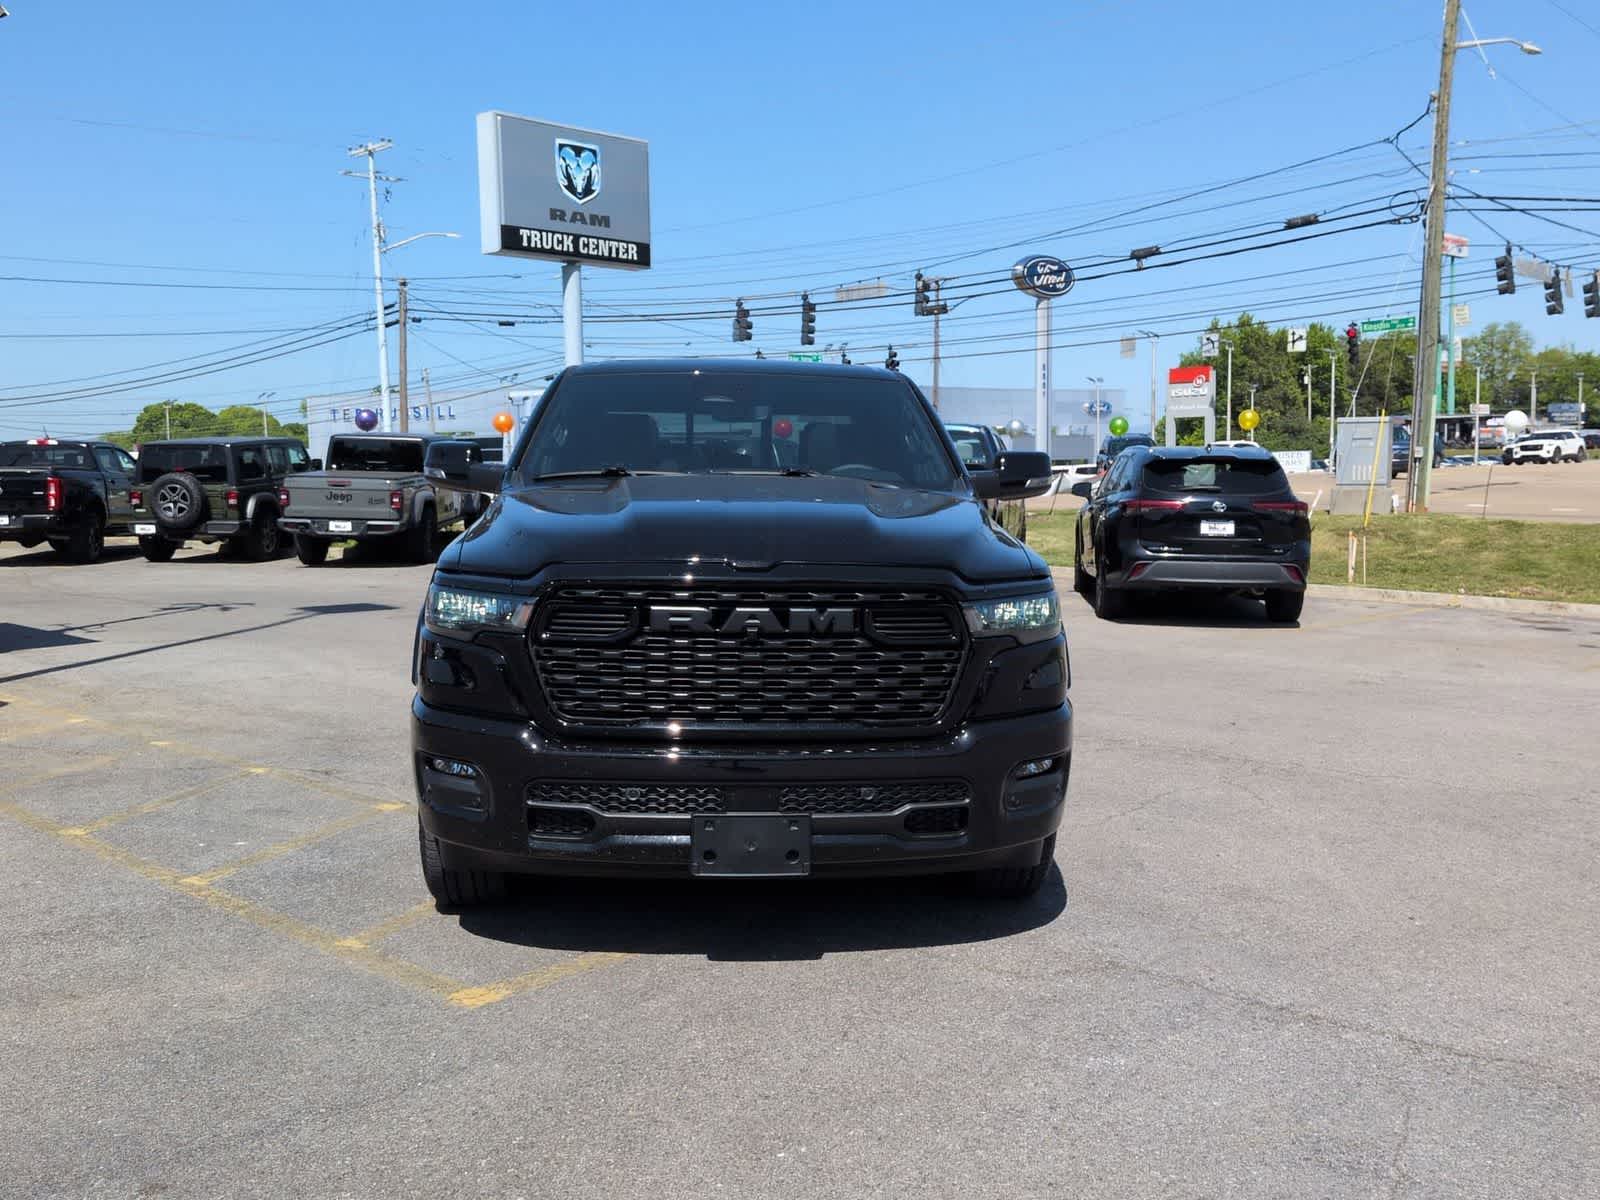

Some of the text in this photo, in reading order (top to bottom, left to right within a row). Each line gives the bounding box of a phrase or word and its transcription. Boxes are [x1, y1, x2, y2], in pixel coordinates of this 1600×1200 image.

[549, 207, 611, 229] RAM
[519, 229, 638, 261] TRUCK CENTER
[1033, 262, 1067, 289] Ford
[1171, 387, 1208, 397] ISUZU
[326, 491, 353, 503] Jeep
[651, 605, 855, 633] RAM
